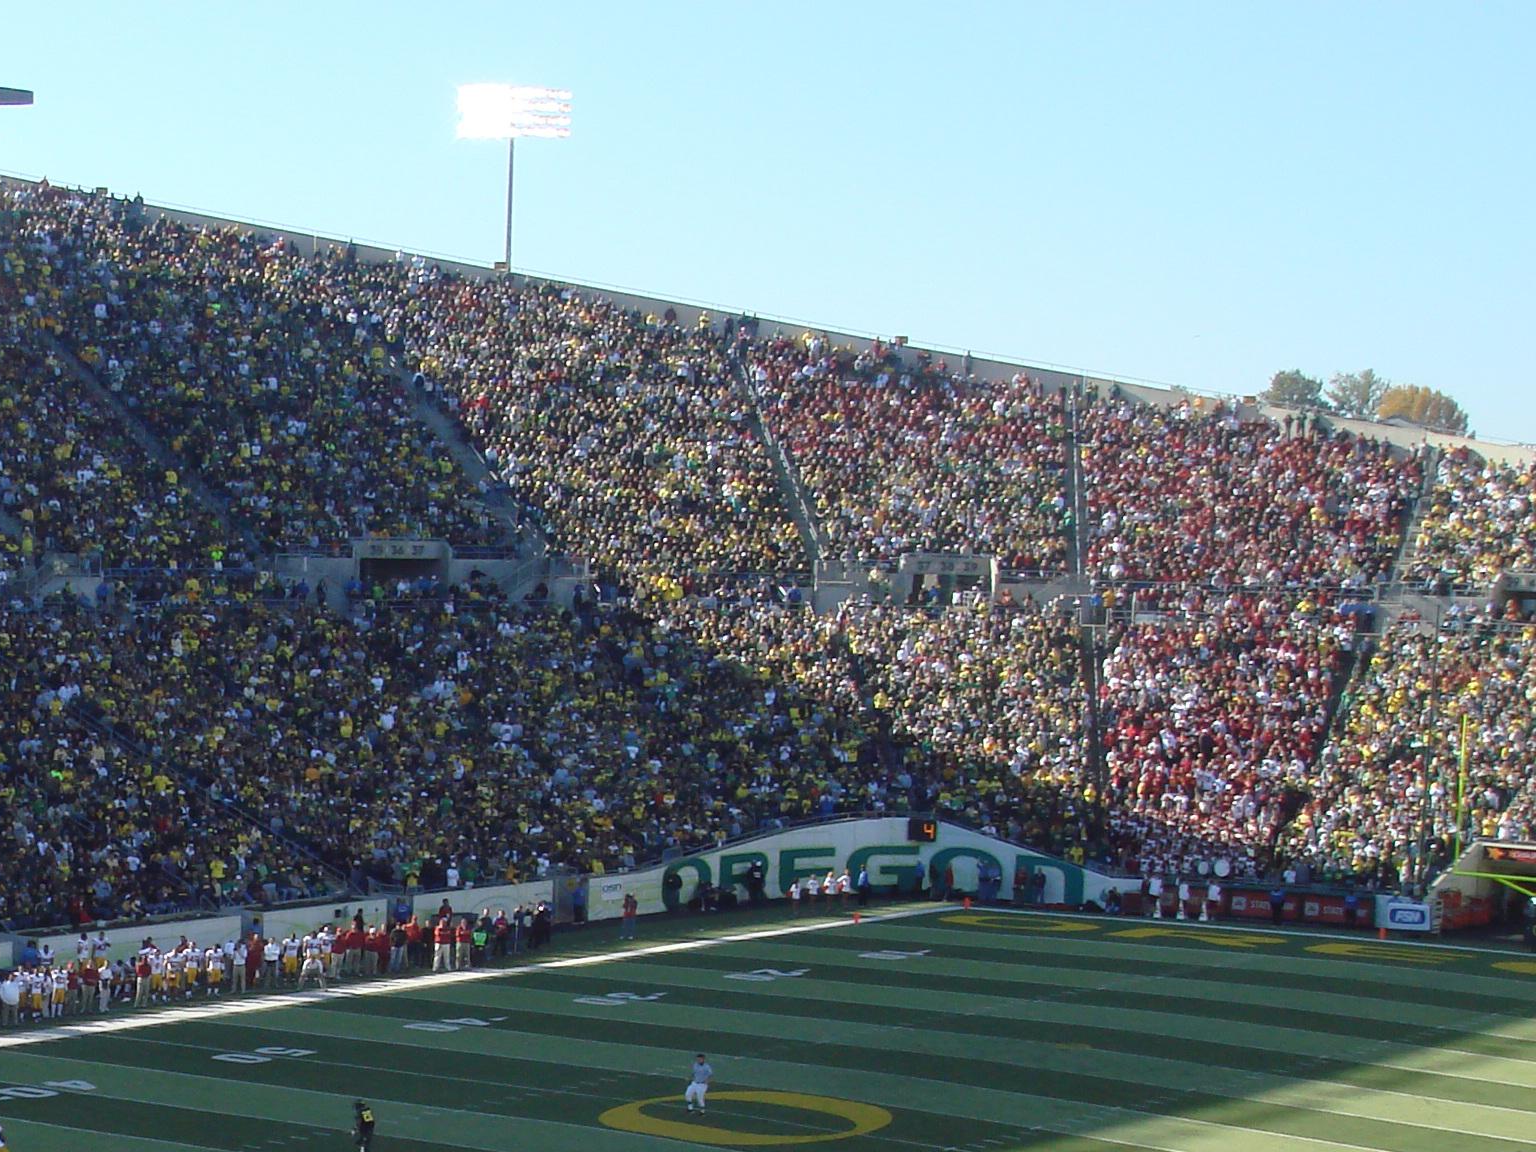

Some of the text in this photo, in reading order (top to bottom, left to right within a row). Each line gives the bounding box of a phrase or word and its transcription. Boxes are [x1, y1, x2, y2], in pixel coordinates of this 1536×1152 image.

[923, 823, 935, 840] 4
[662, 846, 1083, 912] OREGON
[1394, 910, 1421, 922] FSN
